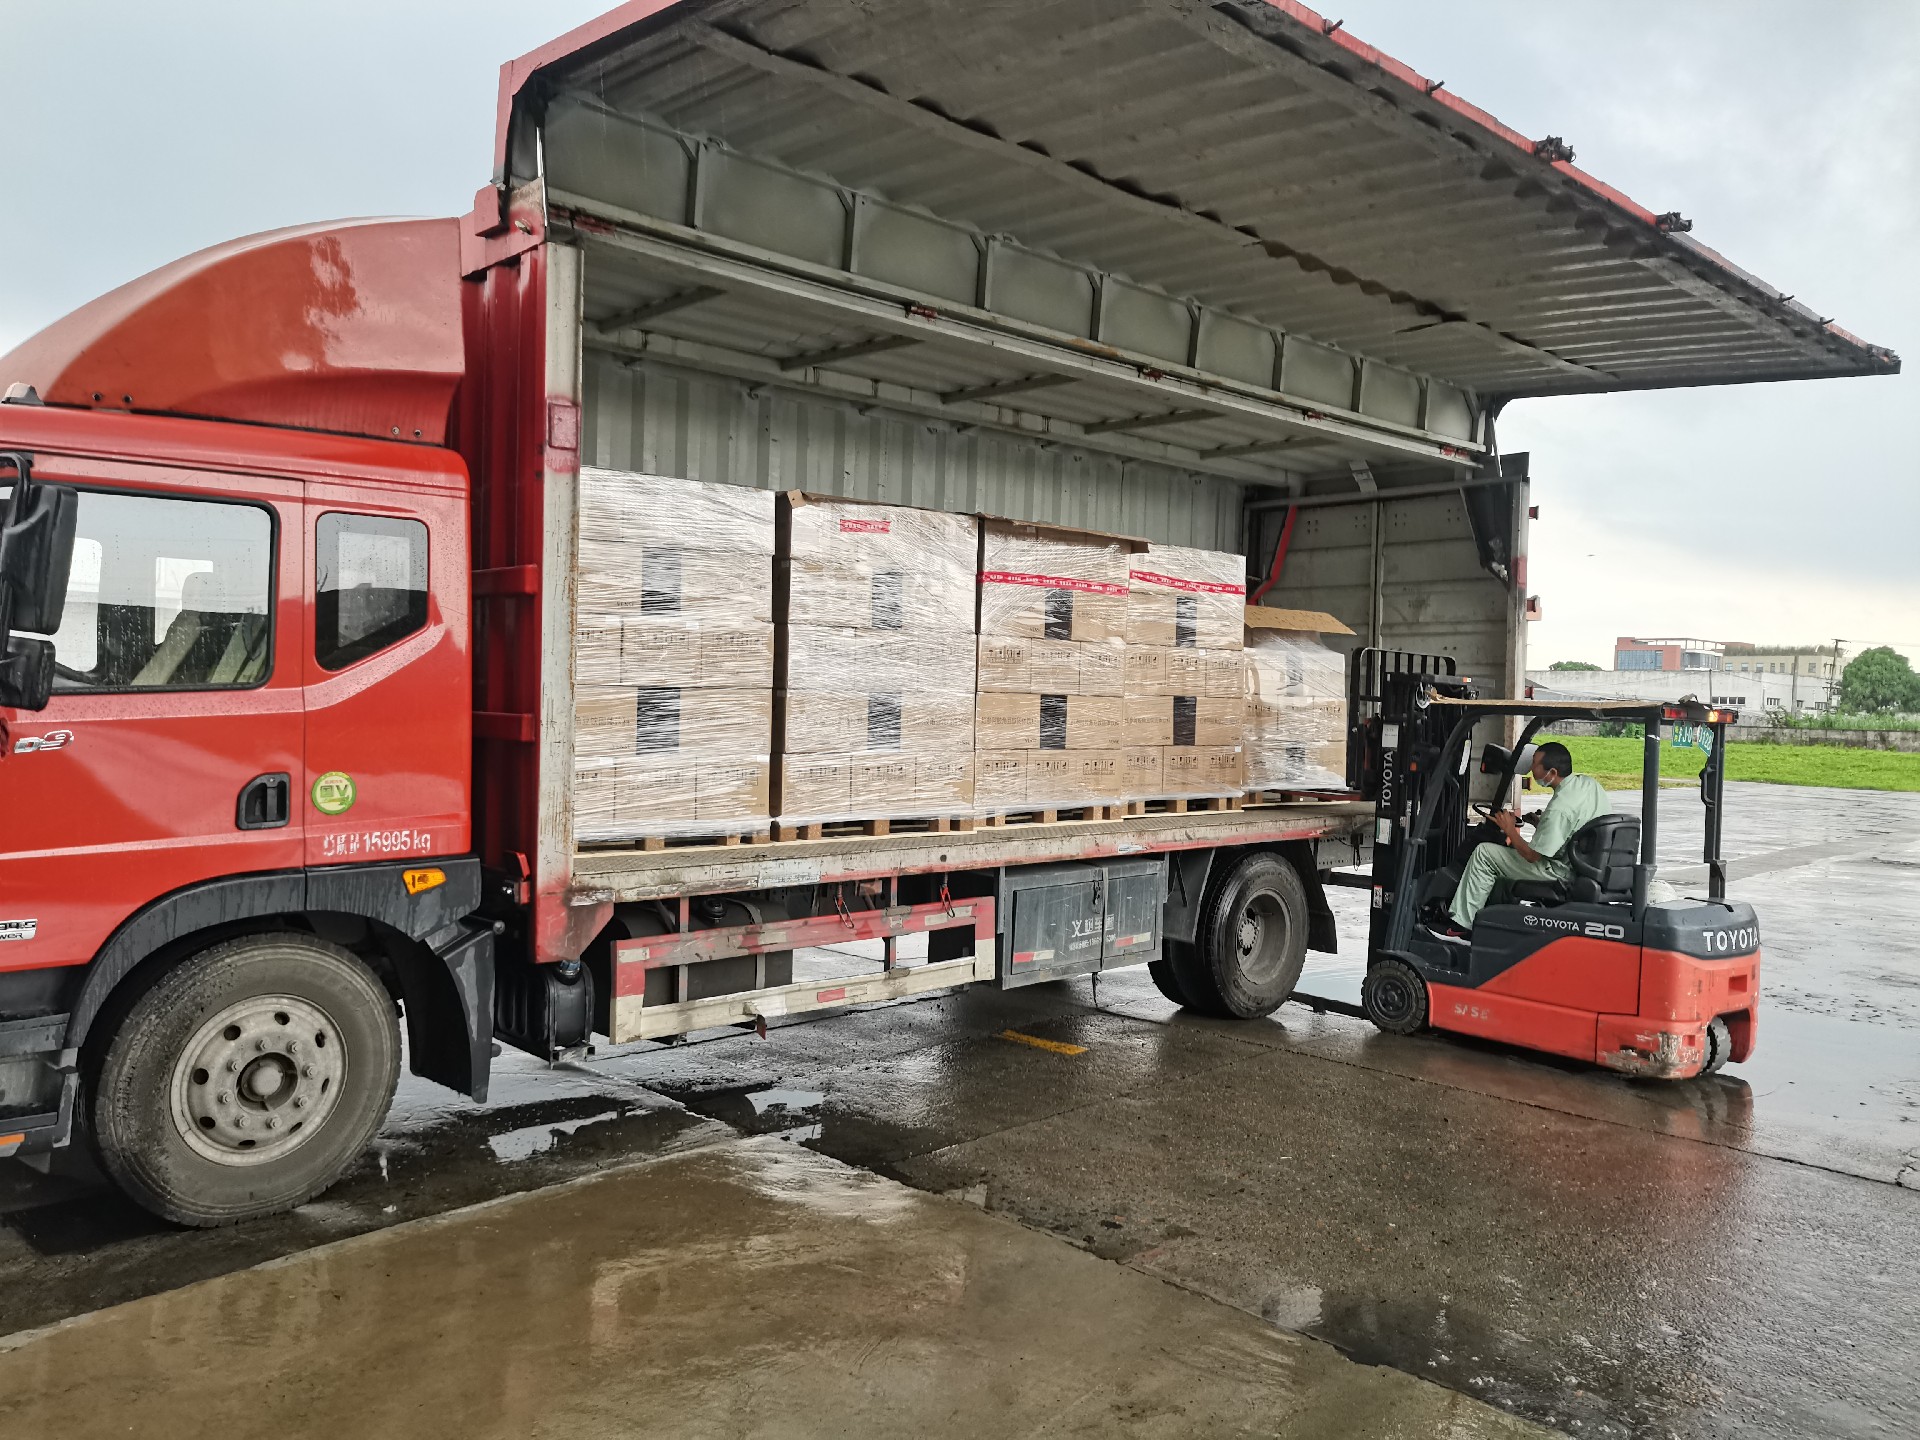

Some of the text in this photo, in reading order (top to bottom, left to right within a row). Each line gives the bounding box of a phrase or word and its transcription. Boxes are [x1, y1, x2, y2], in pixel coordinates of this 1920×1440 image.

[1382, 750, 1393, 809] TOYOTA
[1540, 918, 1625, 939] TOYOTA 20
[1702, 926, 1759, 952] TOYOTA
